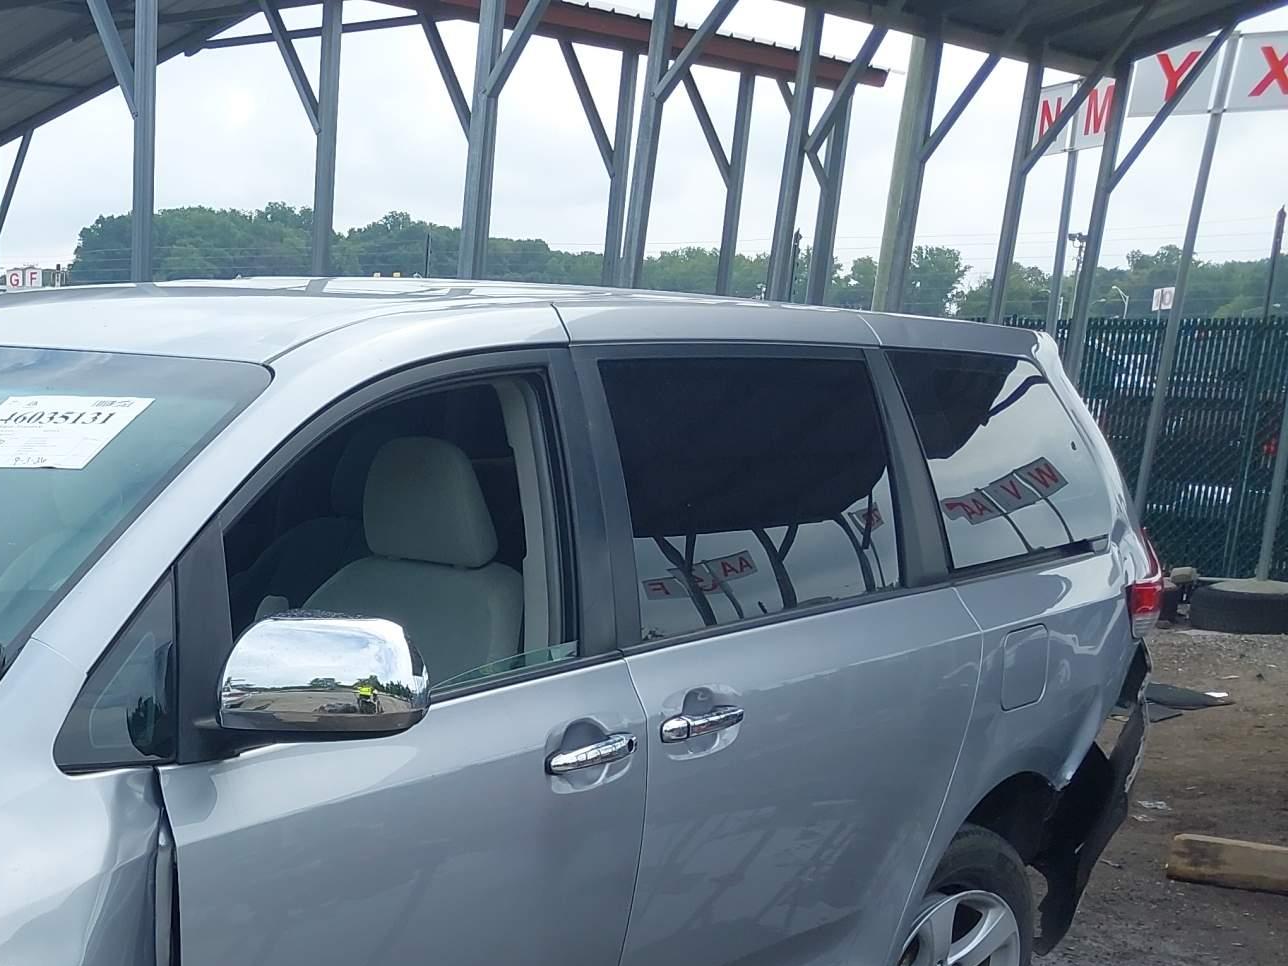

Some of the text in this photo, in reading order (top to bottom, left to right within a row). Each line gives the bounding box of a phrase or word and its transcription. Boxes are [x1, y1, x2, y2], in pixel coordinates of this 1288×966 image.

[1156, 51, 1202, 102] Y
[9, 272, 20, 287] G
[30, 271, 37, 287] F
[0, 411, 117, 425] 46035131
